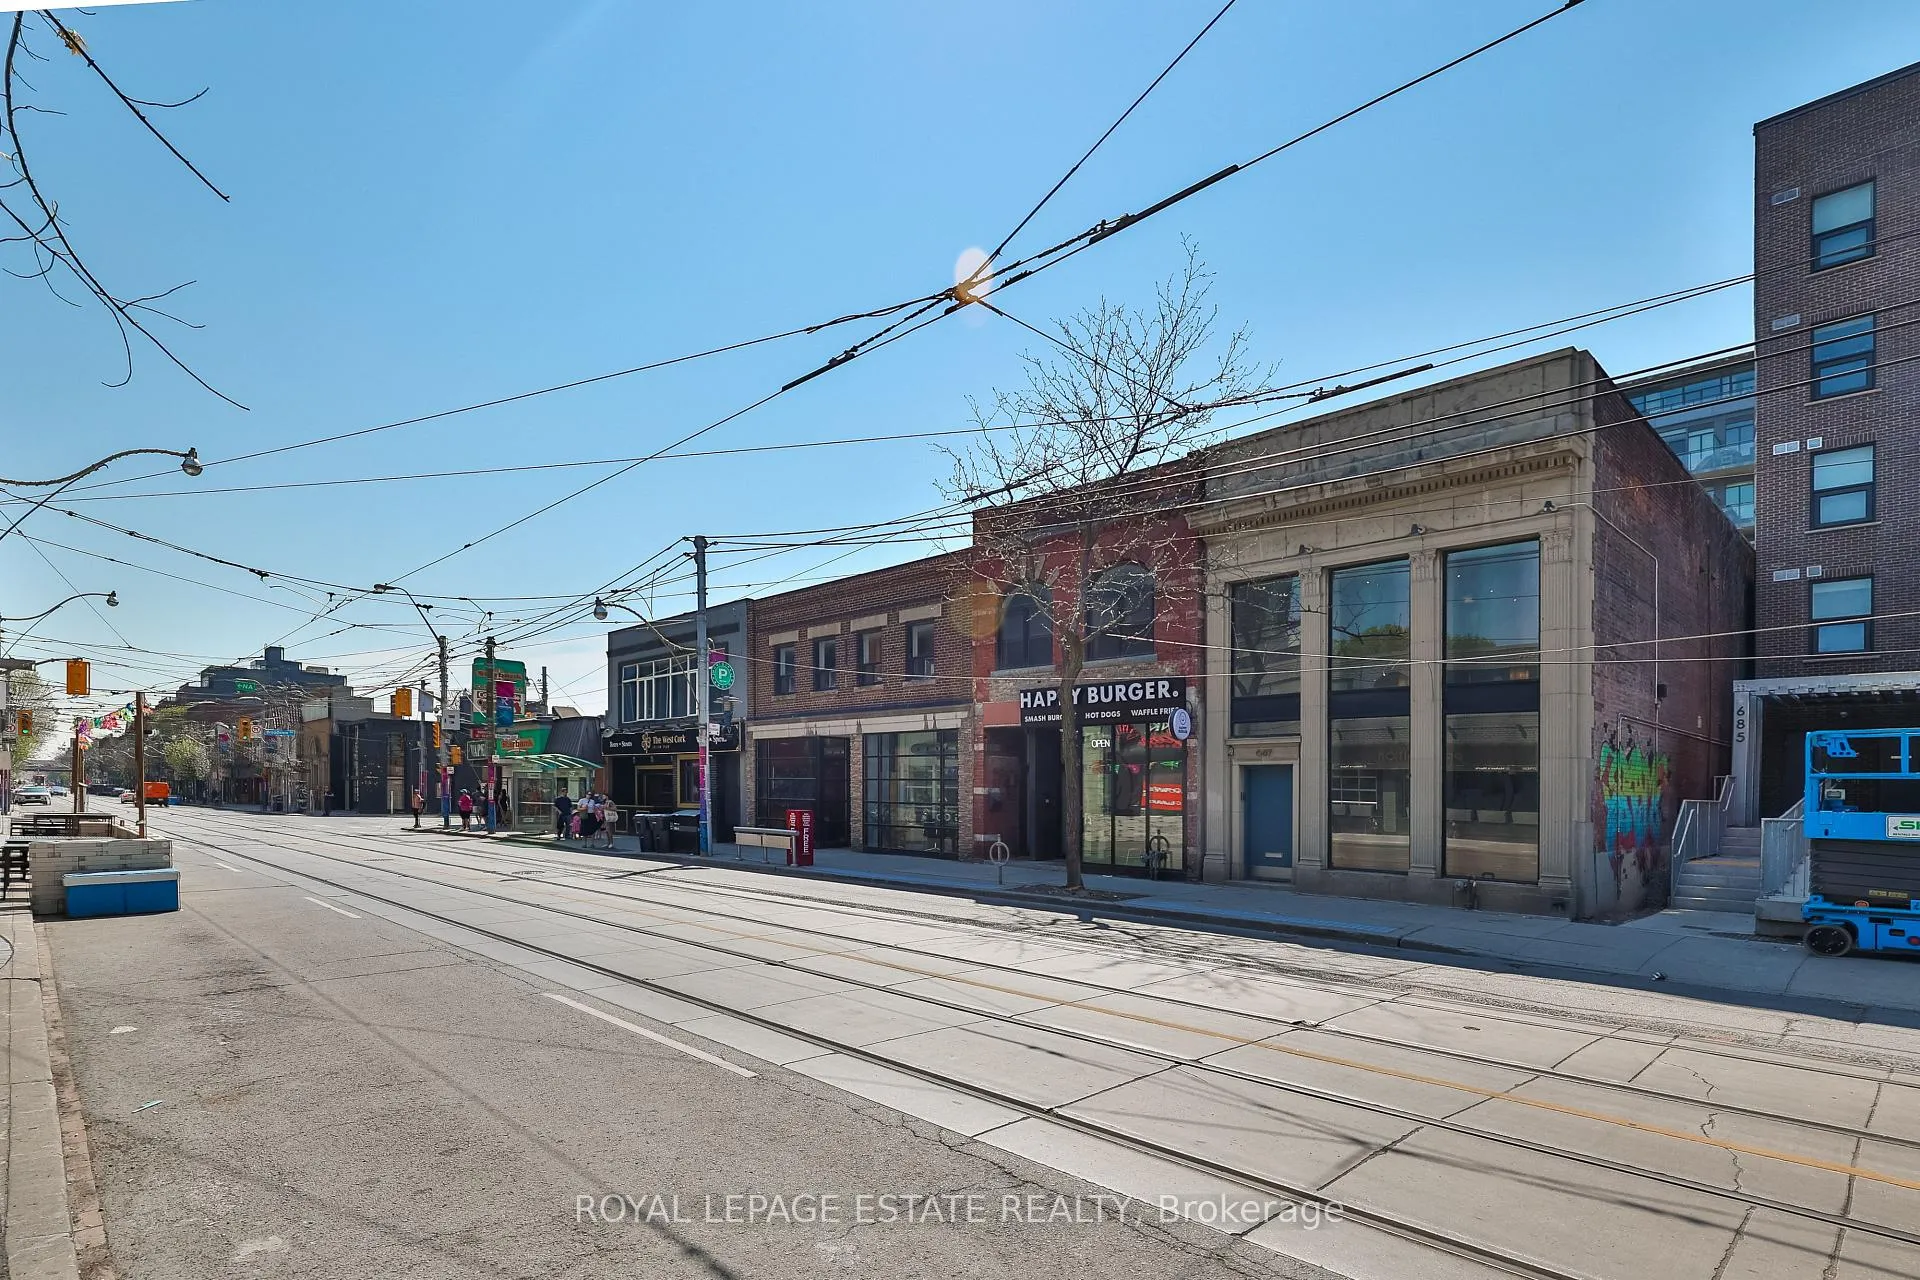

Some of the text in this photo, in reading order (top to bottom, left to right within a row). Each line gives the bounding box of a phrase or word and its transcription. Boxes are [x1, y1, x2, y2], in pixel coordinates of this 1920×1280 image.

[718, 668, 728, 679] P
[1020, 688, 1081, 709] HAPY
[1131, 707, 1179, 717] WAFFLE FRIE
[1024, 715, 1047, 723] SMASH
[662, 736, 675, 744] West
[1091, 739, 1111, 748] OPEN
